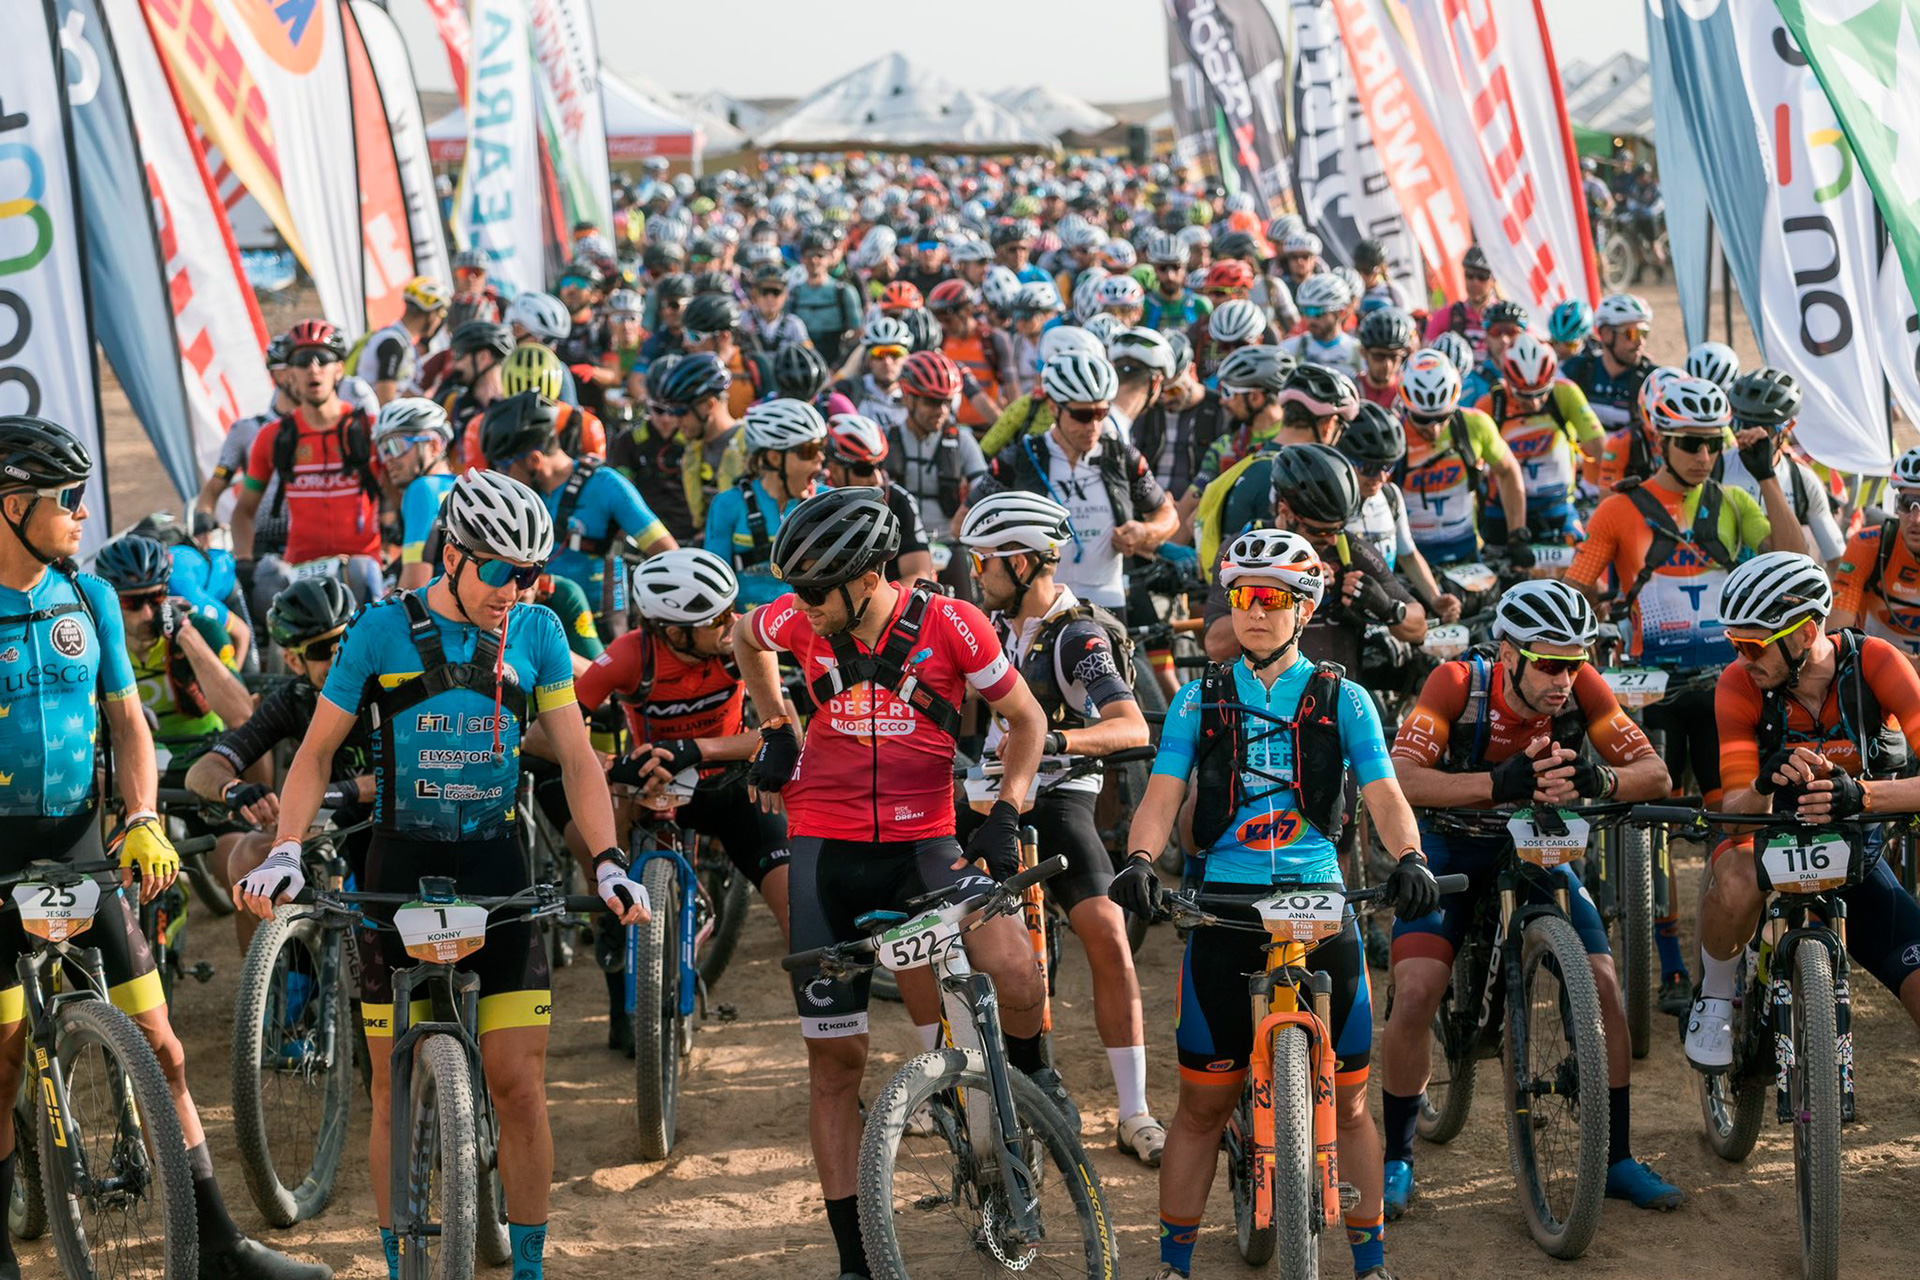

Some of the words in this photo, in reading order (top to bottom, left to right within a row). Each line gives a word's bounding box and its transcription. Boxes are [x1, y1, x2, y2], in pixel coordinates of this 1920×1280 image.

[942, 604, 980, 657] ŠKODA
[0, 663, 89, 692] uesca
[1619, 674, 1648, 686] 27
[836, 720, 909, 732] MOROCCO
[1611, 729, 1644, 753] LIC
[419, 750, 491, 763] ELYSATOR
[1782, 845, 1831, 872] 116
[38, 886, 77, 907] 25
[1269, 895, 1332, 911] 202
[45, 910, 72, 918] JESUS
[433, 908, 448, 929] 1
[427, 930, 462, 942] KONNY
[892, 930, 943, 967] 522
